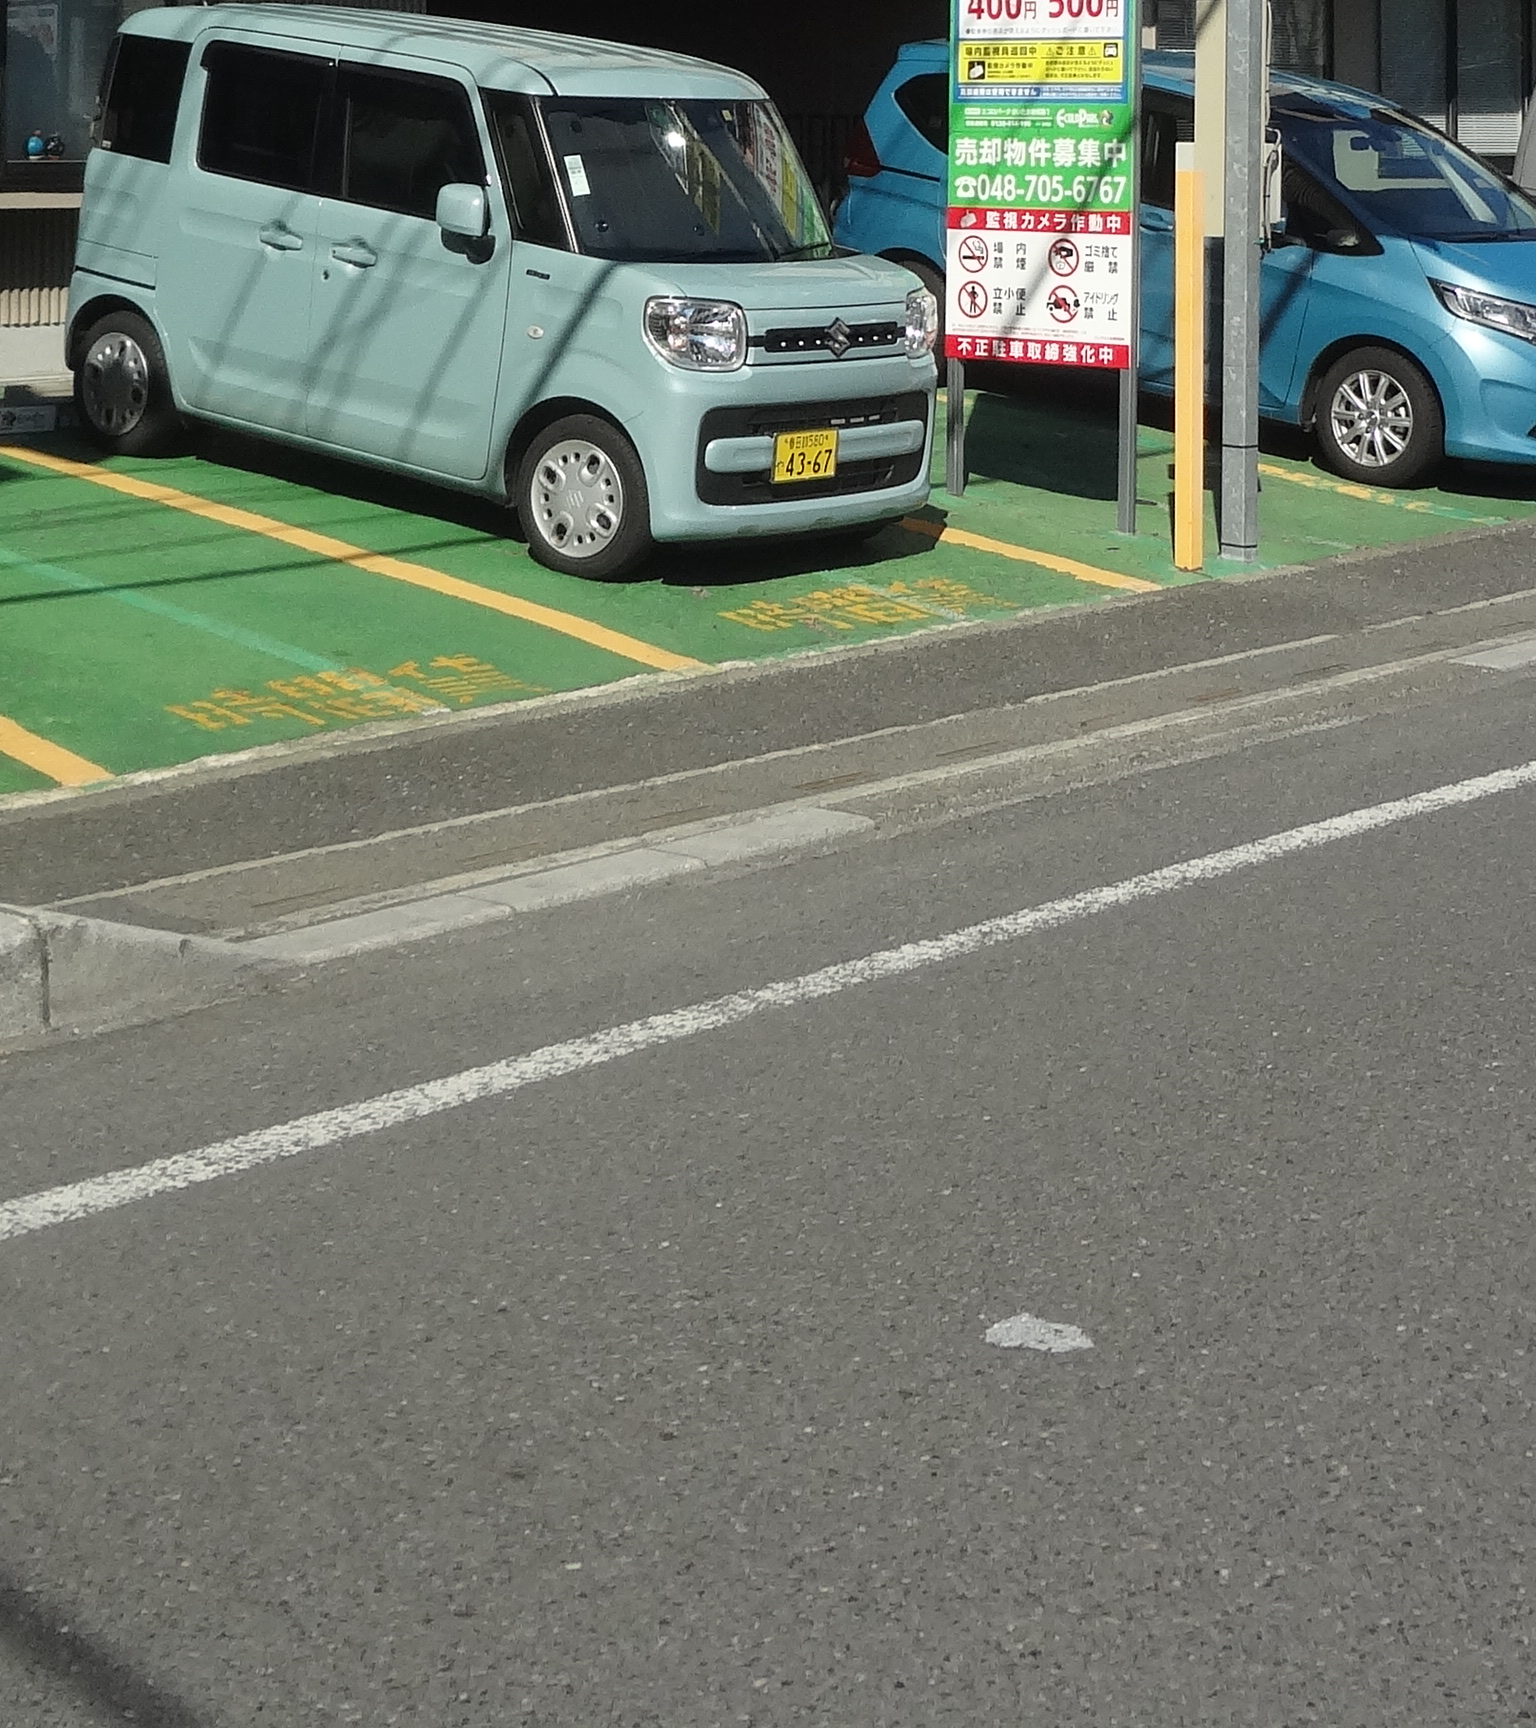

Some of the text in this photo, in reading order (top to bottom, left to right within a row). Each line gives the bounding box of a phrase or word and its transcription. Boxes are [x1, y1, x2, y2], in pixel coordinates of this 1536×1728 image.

[955, 137, 1127, 168] 売却物件募集中
[977, 174, 1127, 203] 048-705-6767
[986, 211, 1121, 233] 監視カメラ作動中
[1084, 245, 1118, 259] ゴミ捨て
[993, 287, 1026, 300] 立小便
[1083, 291, 1119, 306] アイドリング
[958, 337, 1114, 364] 不正駐車取締強化中
[786, 448, 833, 477] 43-67
